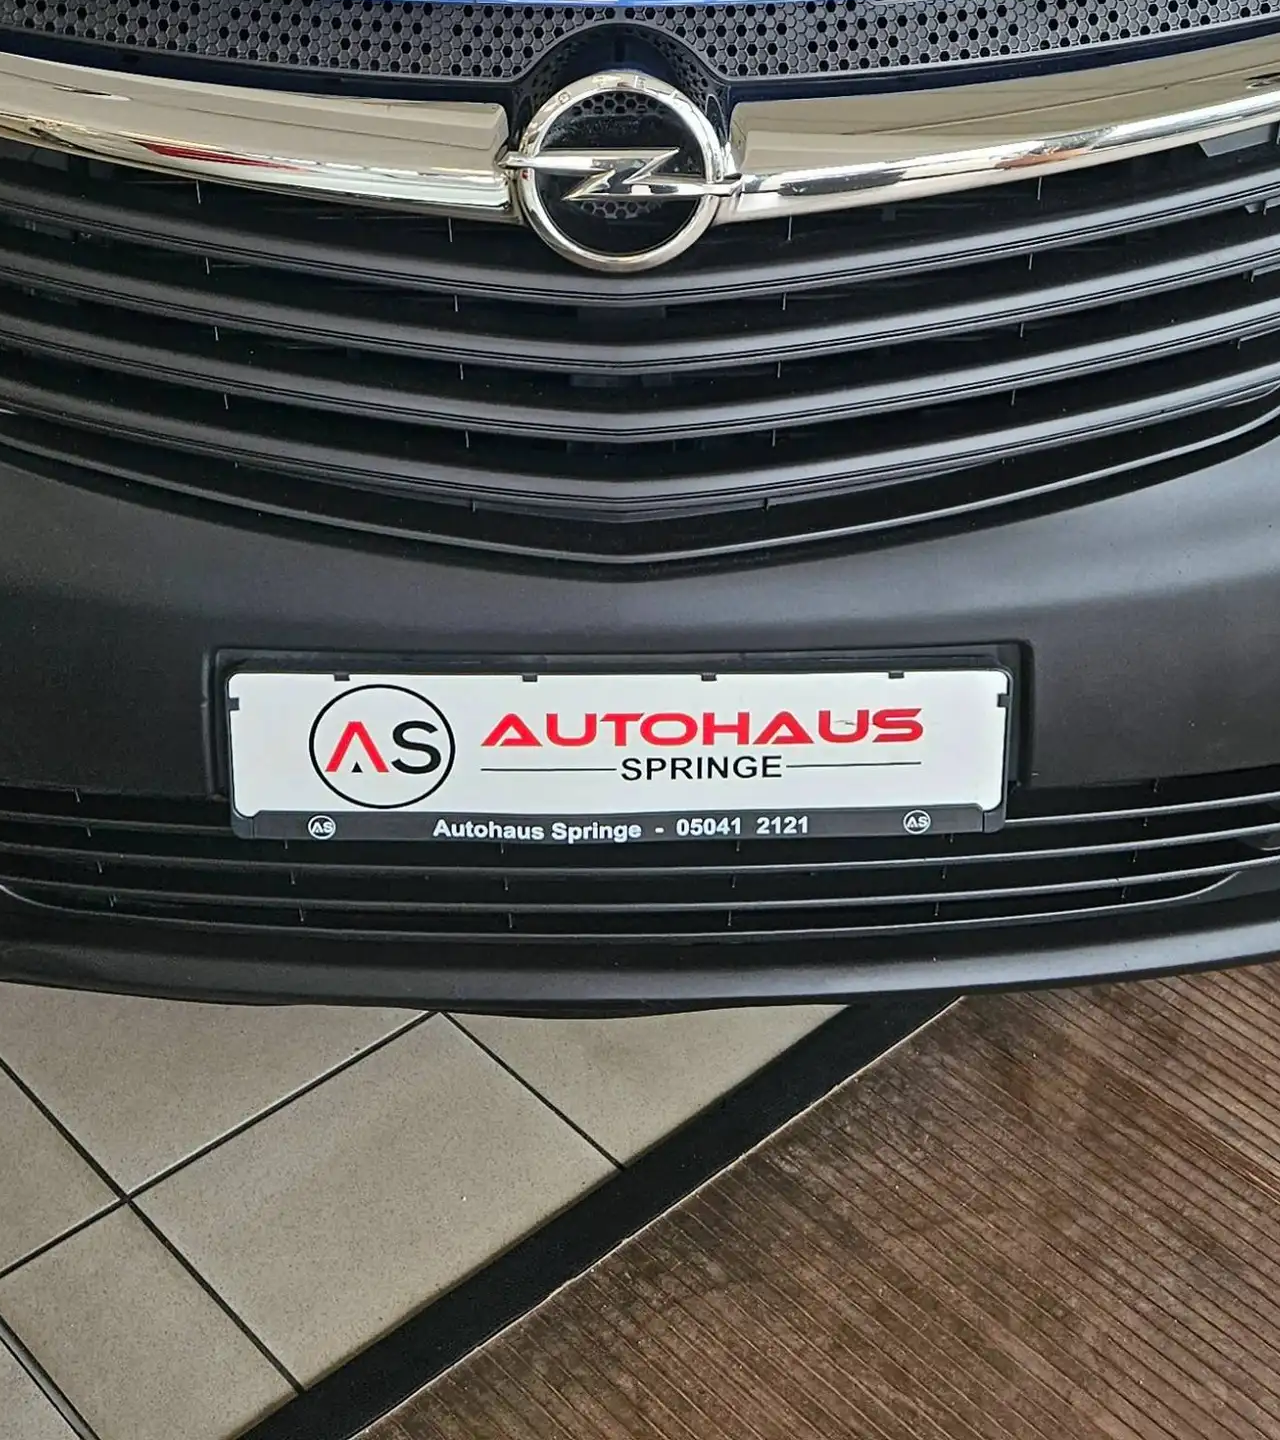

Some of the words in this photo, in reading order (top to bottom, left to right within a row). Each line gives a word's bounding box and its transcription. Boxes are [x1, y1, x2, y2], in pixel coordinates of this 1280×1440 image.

[480, 707, 924, 748] AUTOHAUS
[324, 720, 442, 775] AS
[621, 755, 783, 781] SPRINGE
[432, 818, 545, 841] Autohaus
[550, 821, 643, 844] Springe
[675, 817, 742, 837] 05041
[755, 815, 809, 835] 2121
